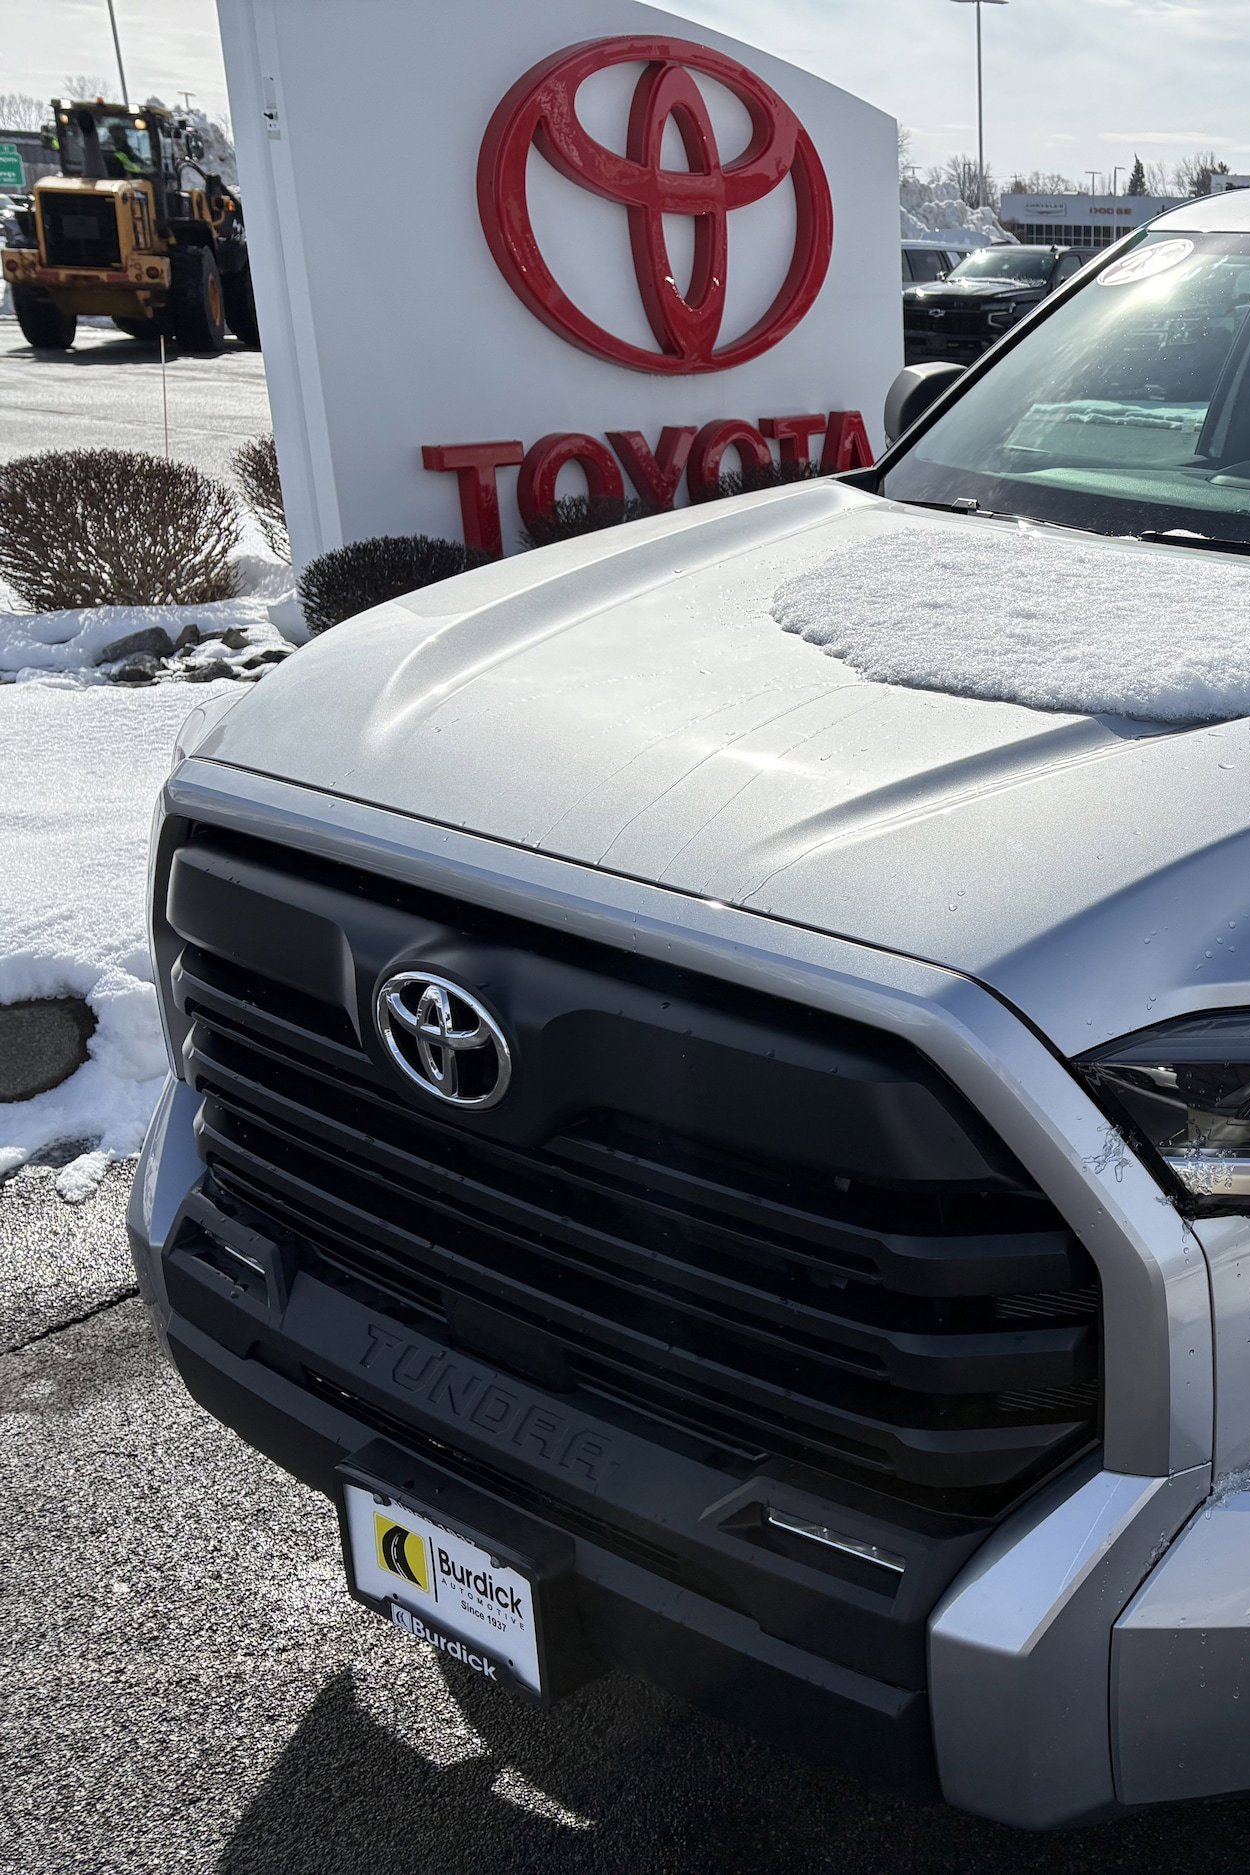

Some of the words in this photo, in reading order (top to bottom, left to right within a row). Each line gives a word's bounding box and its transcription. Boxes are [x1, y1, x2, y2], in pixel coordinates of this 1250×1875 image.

[1089, 207, 1132, 215] DODGE
[422, 410, 875, 558] TOYOTA
[359, 1323, 613, 1481] TUNDRA
[437, 1547, 523, 1620] Burdick
[441, 1578, 525, 1631] AUTOMOTIVE
[461, 1600, 485, 1621] Since
[487, 1615, 507, 1632] 1937
[413, 1619, 497, 1681] Burdick
